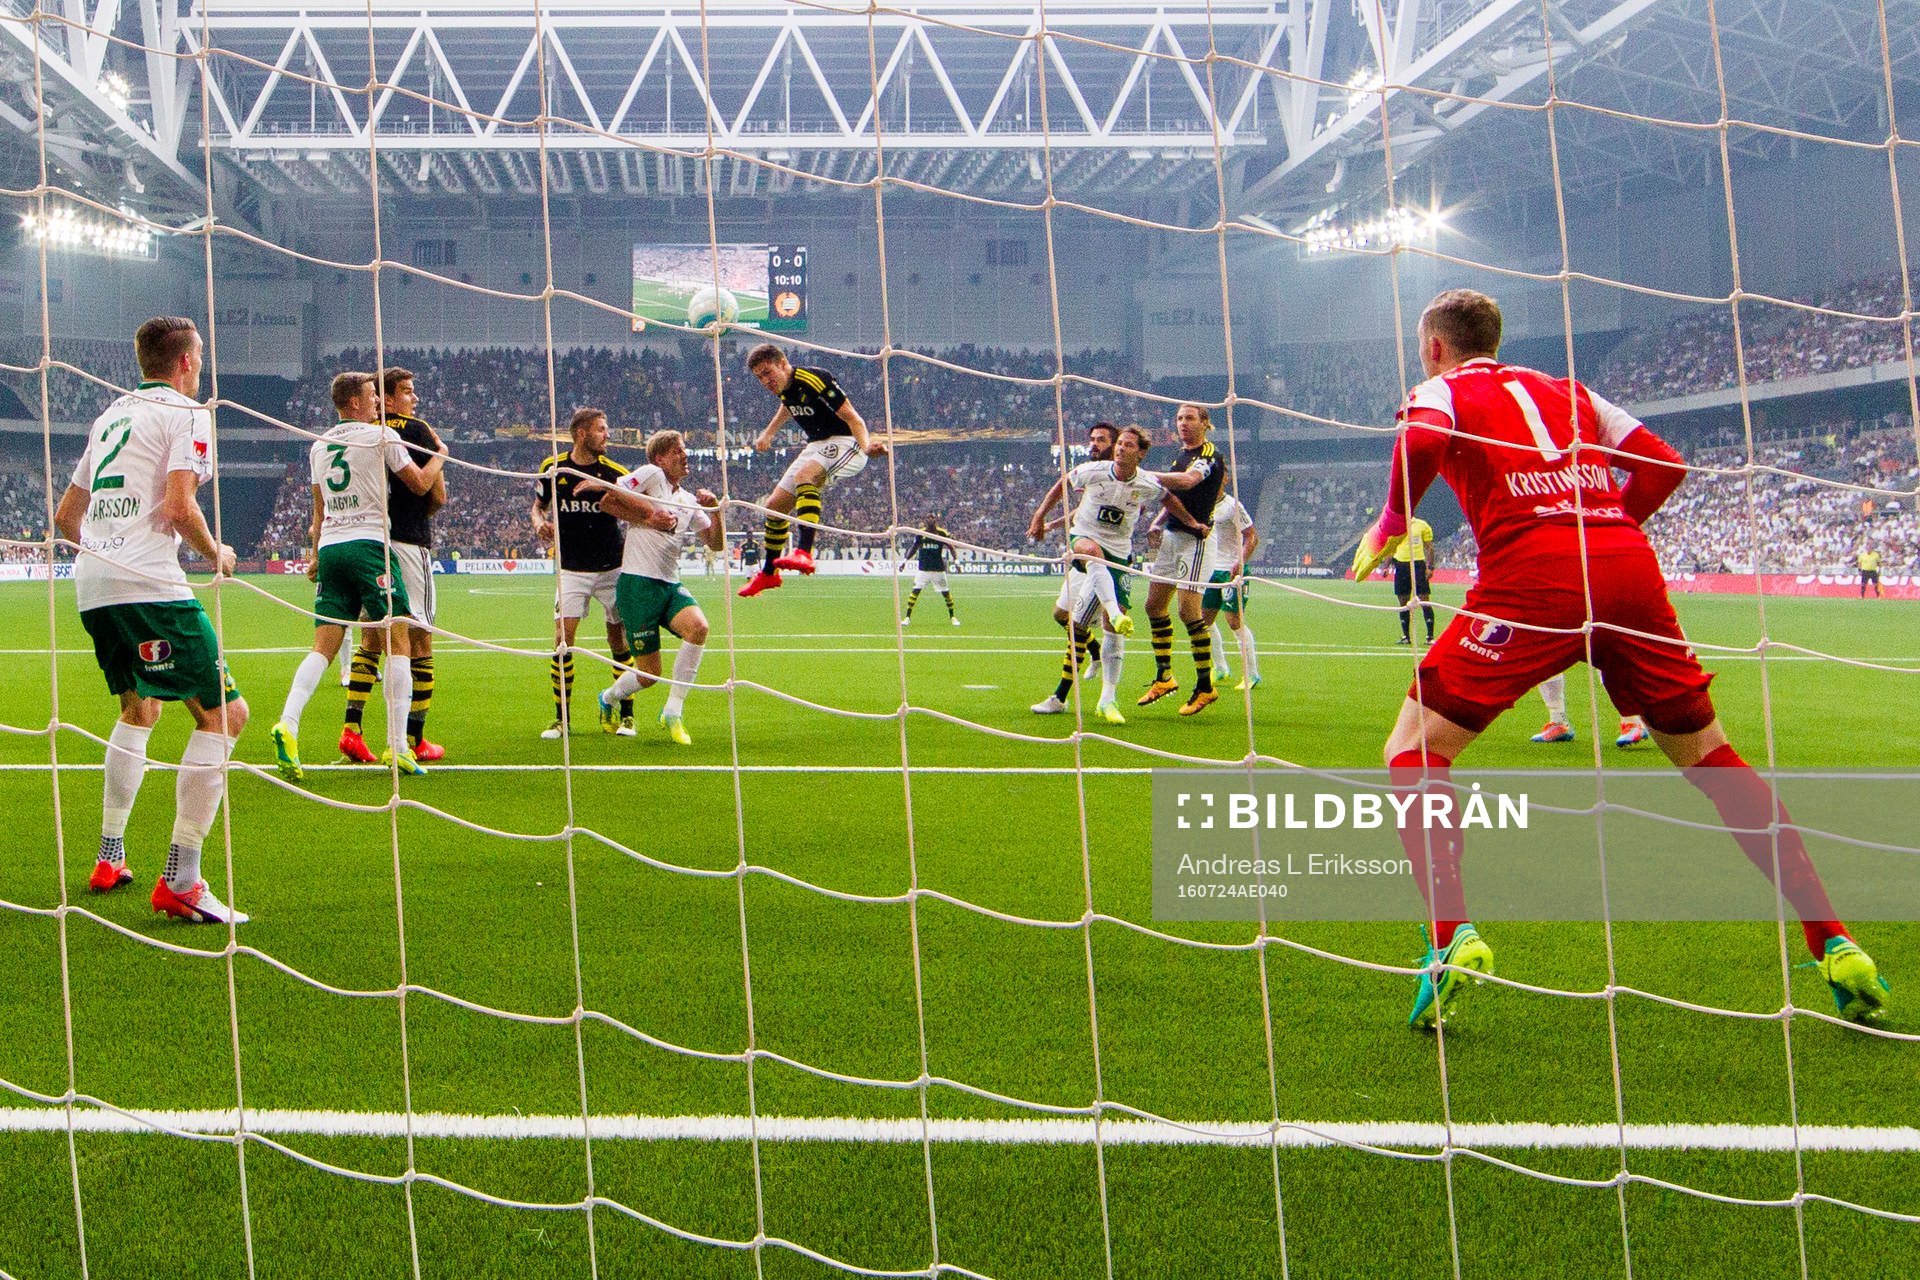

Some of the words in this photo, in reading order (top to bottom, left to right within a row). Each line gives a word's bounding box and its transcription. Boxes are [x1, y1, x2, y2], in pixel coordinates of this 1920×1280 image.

[773, 255, 781, 267] 0
[794, 255, 802, 267] 0
[774, 275, 802, 285] 10:10
[1503, 380, 1562, 462] 1
[91, 416, 132, 494] 2
[326, 443, 351, 492] 3
[1504, 463, 1609, 497] KRISTINSSON
[464, 562, 503, 571] PELIKAN
[990, 562, 1044, 574] JÄGAREN
[1458, 635, 1502, 662] fronta
